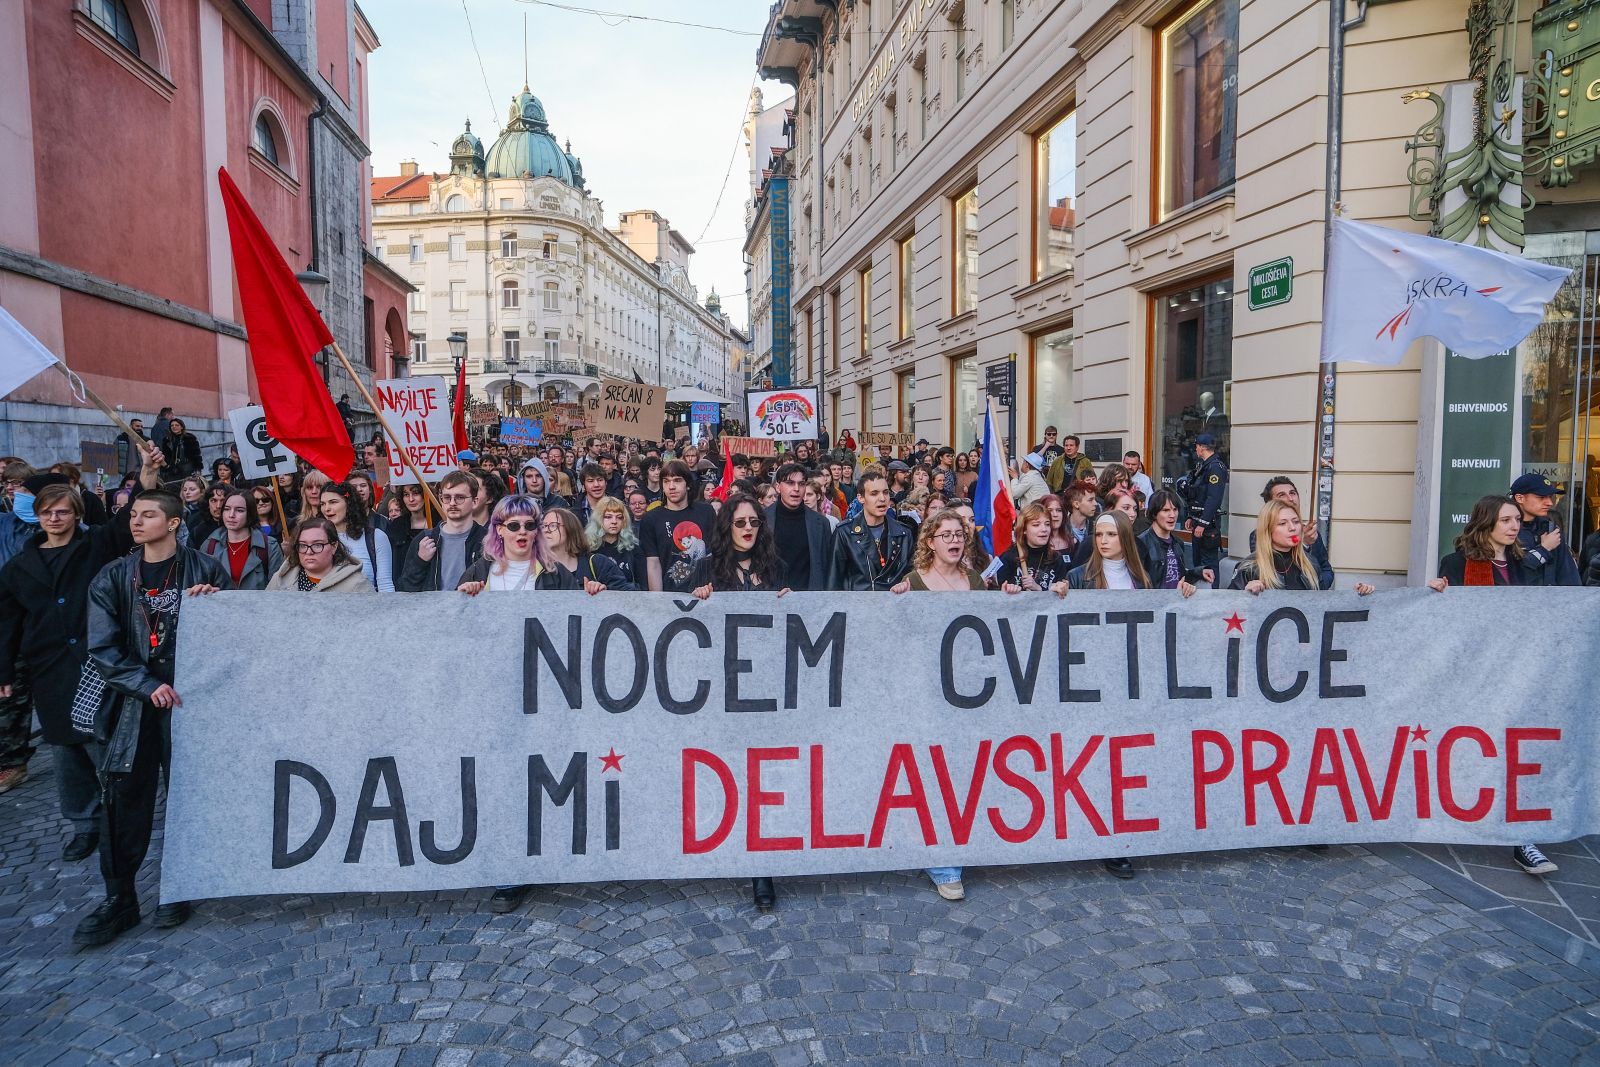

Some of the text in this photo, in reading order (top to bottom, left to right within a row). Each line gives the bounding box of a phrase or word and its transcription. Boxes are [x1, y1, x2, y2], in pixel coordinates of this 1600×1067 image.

[852, 41, 896, 122] GALERIJA
[539, 201, 561, 211] UNION
[773, 189, 789, 289] EMPORIUM
[1261, 285, 1278, 299] CESTA
[1406, 273, 1468, 304] ISKRA
[605, 384, 654, 405] SREČAN 8
[1449, 402, 1508, 413] BIENVENIDOS
[692, 413, 717, 422] TERFS
[766, 418, 801, 436] ŠOLE
[405, 420, 429, 443] NI
[1451, 458, 1500, 468] BENVENUTI
[1452, 514, 1471, 524] WEL
[522, 600, 847, 715] NOČEM
[271, 756, 478, 869] DAJ
[682, 732, 1160, 854] DELAVSKE
